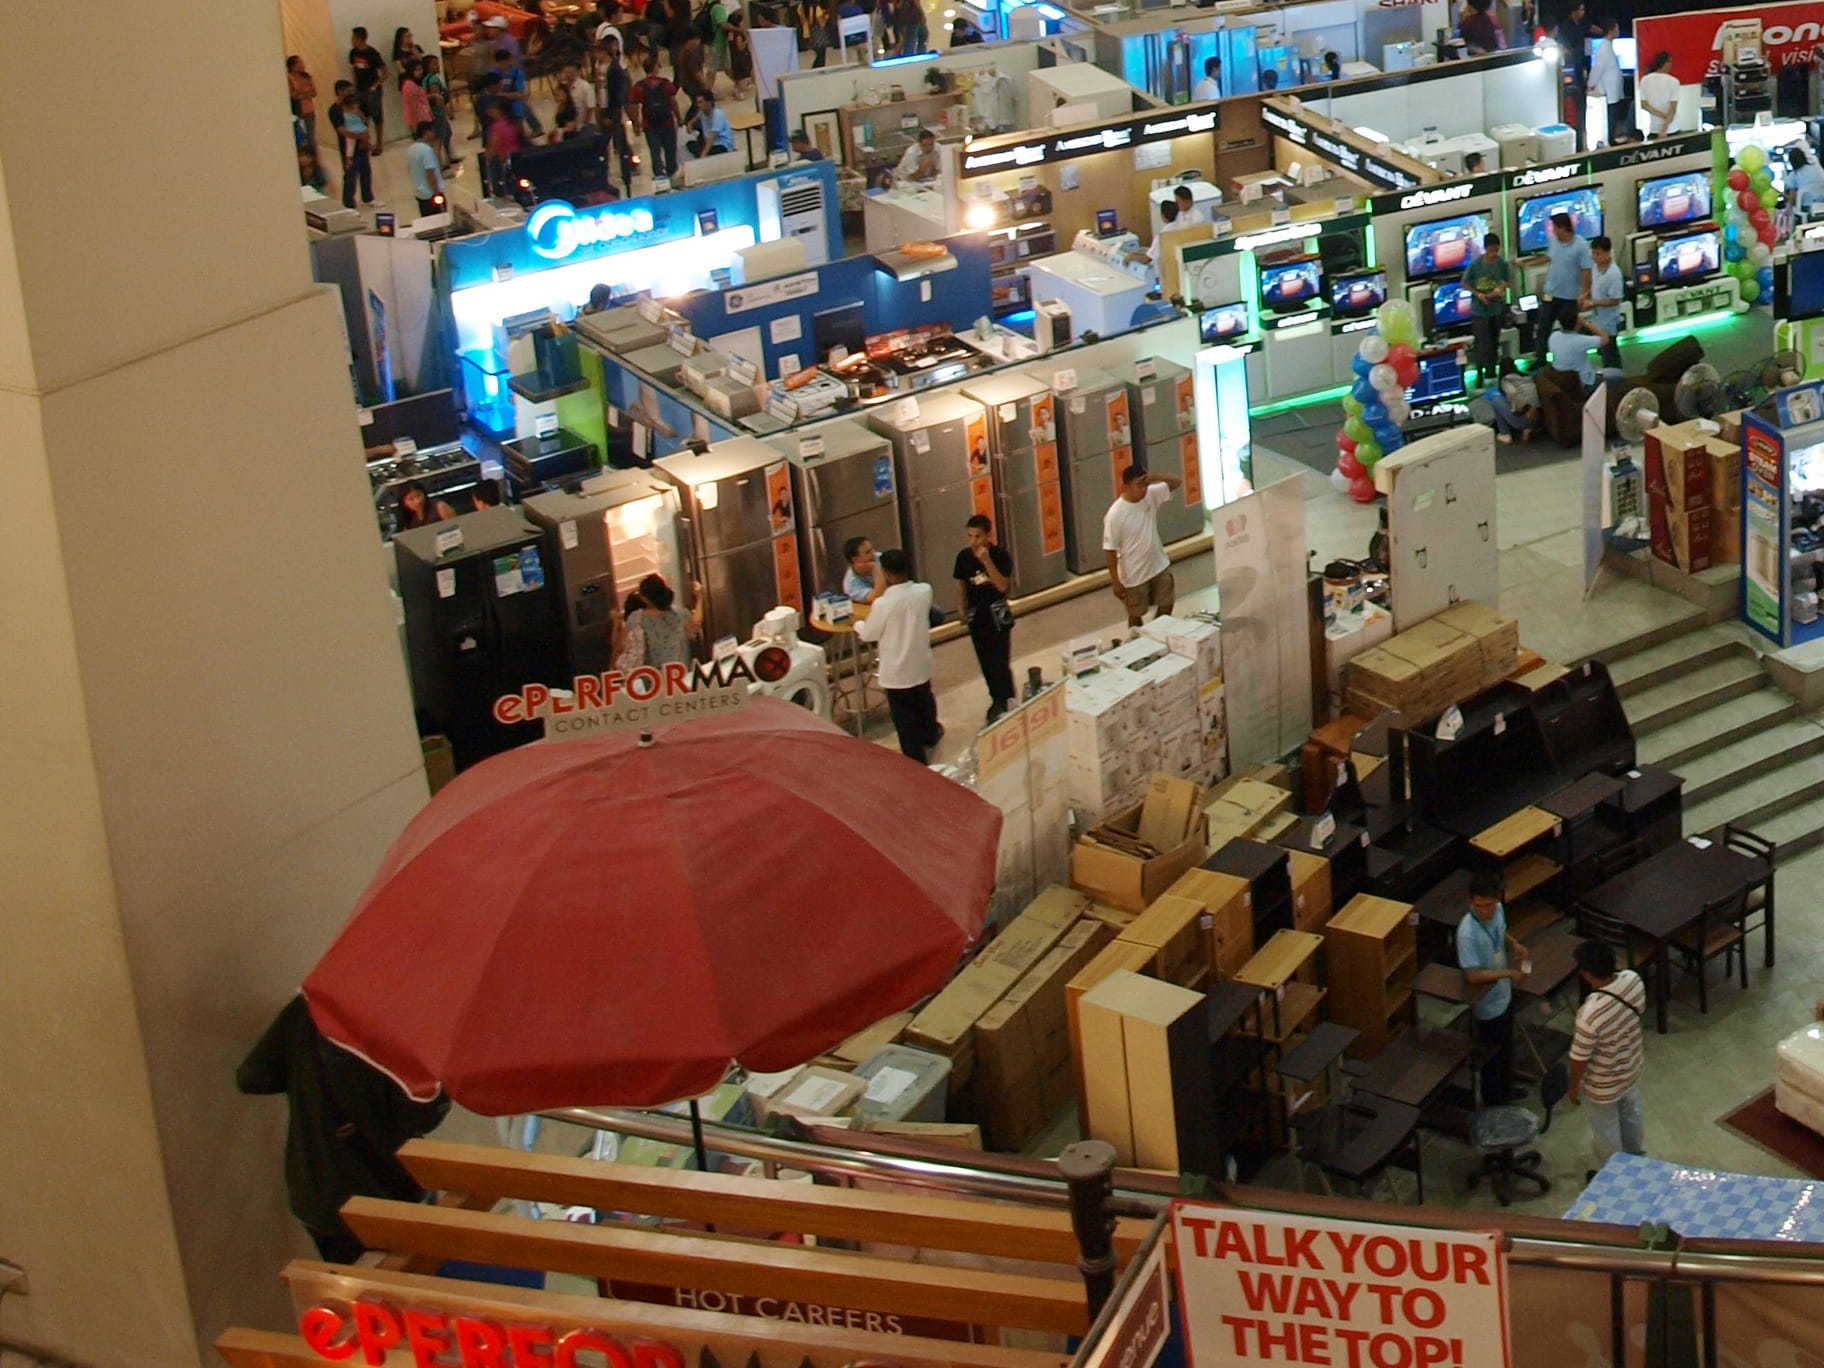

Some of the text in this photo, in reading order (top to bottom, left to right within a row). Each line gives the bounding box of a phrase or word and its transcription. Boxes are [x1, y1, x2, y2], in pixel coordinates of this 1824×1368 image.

[1620, 143, 1685, 166] DÉVANT
[555, 692, 741, 733] CONTACT CENTERS
[1181, 1217, 1491, 1286] TALK YOUR
[675, 1285, 903, 1335] HOT CAREERS
[1237, 1269, 1447, 1330] WAY TO
[1221, 1314, 1464, 1368] THE TOP!
